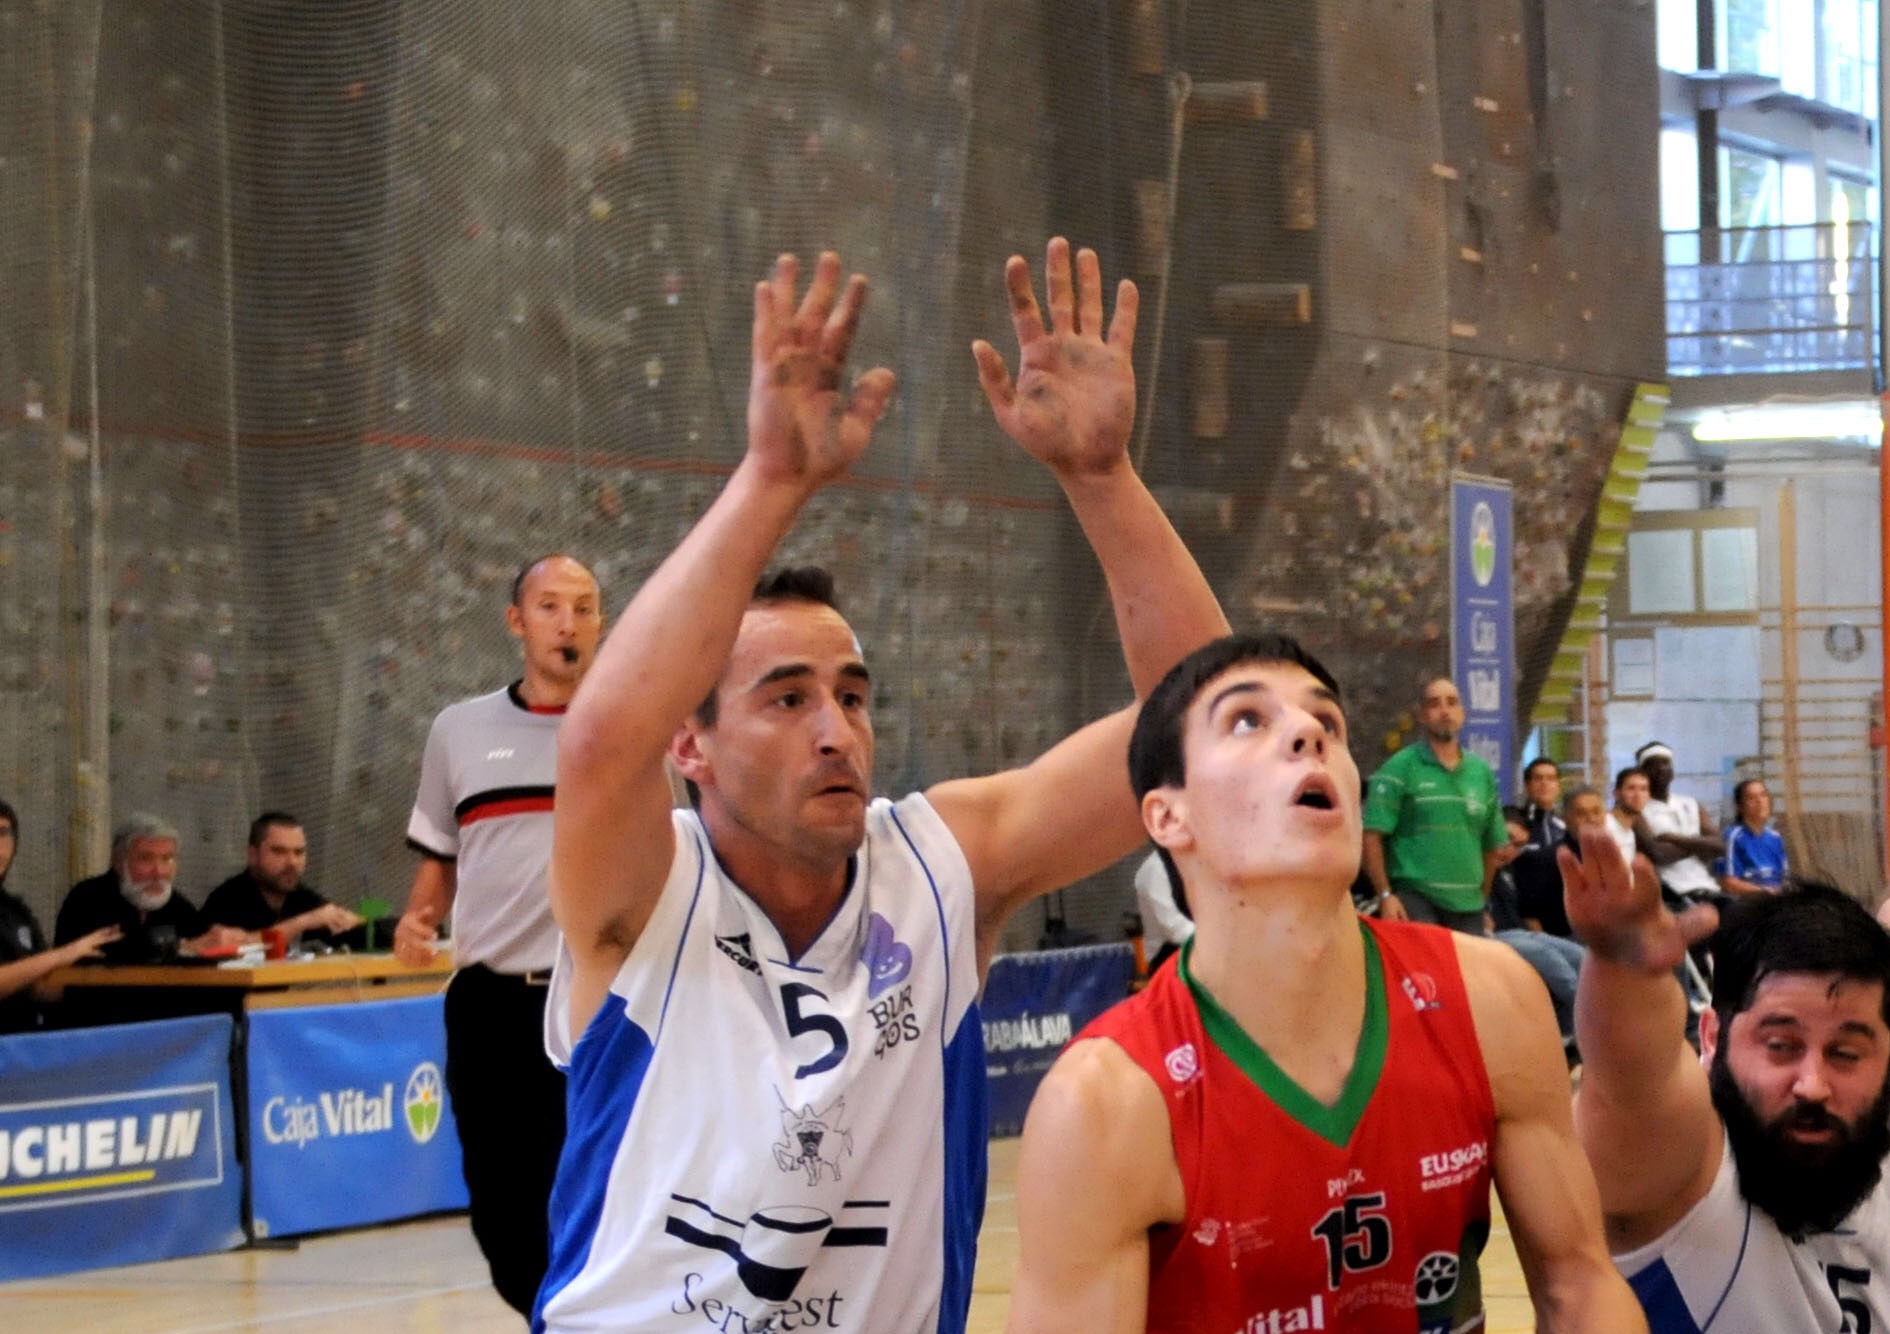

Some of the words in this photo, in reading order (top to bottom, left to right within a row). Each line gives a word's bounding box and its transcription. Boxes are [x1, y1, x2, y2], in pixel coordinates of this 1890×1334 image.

[779, 981, 850, 1080] 5
[263, 1096, 318, 1149] Caja
[321, 1083, 395, 1136] Vital
[1420, 1142, 1488, 1177] EUSKA
[1311, 1190, 1393, 1292] 15
